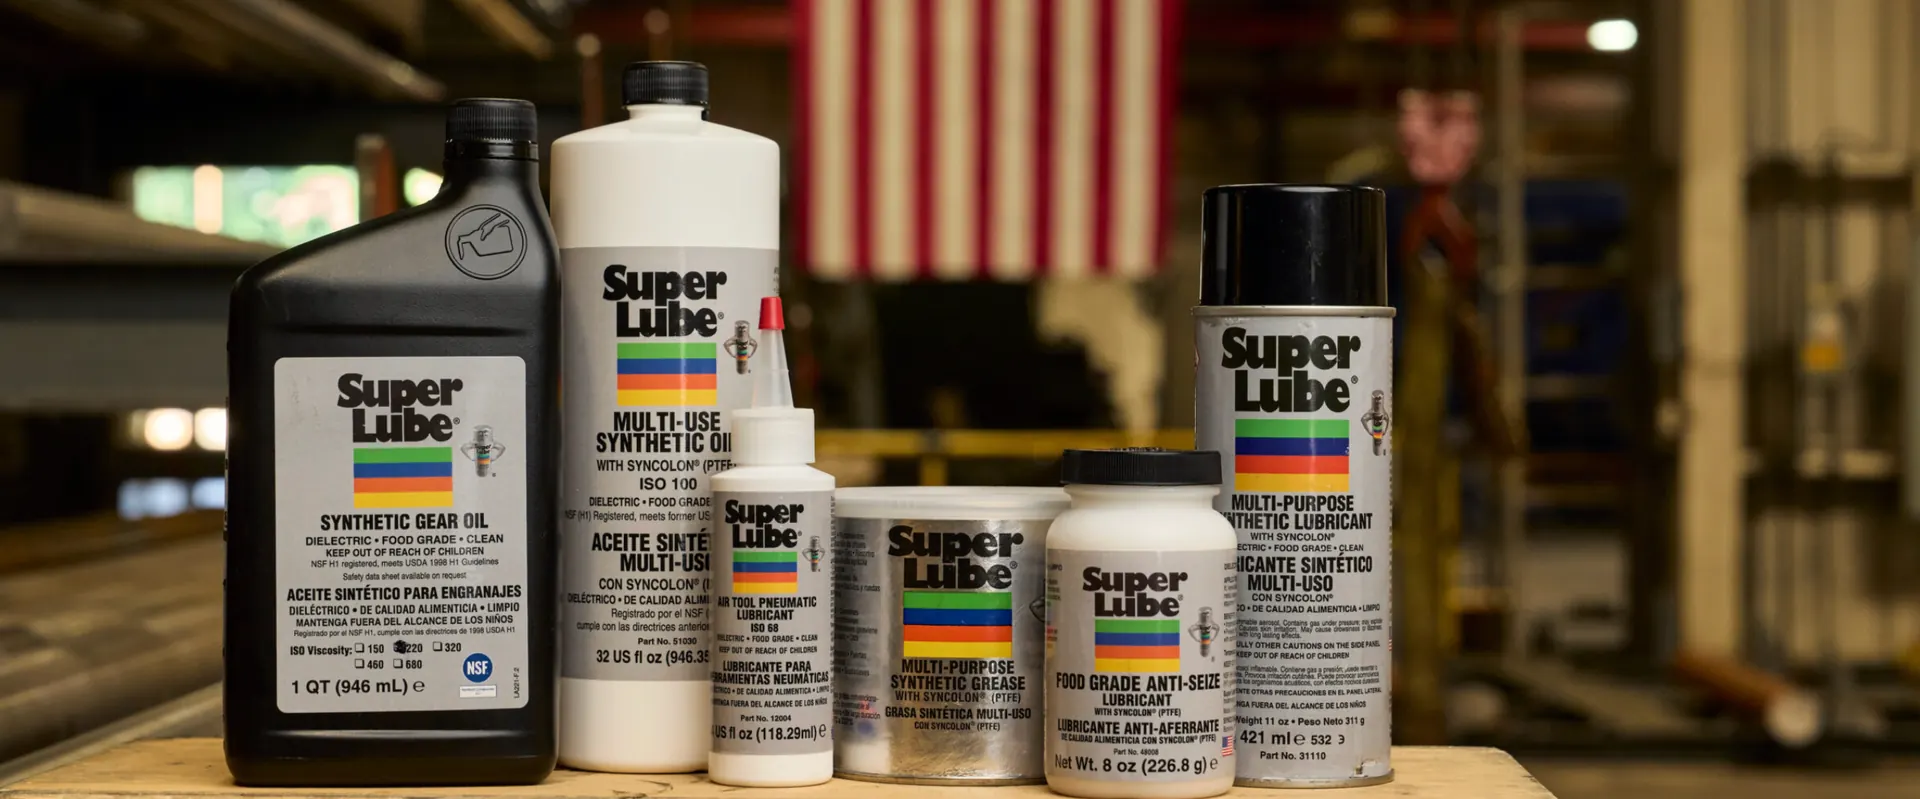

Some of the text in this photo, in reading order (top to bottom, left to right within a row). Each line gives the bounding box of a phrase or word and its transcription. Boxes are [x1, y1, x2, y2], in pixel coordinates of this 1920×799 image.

[603, 264, 727, 306] Super
[1222, 327, 1361, 376] Super
[337, 373, 463, 413] Super
[613, 412, 720, 431] MULTI-USE
[597, 432, 704, 452] SYNTHETIC
[597, 460, 623, 471] WITH
[640, 478, 697, 490] ISO 100
[589, 497, 640, 507] DIELECTRIC
[649, 498, 676, 507] FOOD
[1232, 494, 1354, 512] MULTI-PURPOSE
[725, 500, 804, 527] Super
[321, 513, 488, 530] SYNTHETIC GEAR OIL
[1221, 513, 1372, 530] NTHETIC LUBRICANT
[305, 534, 503, 546] DIELECTRIC FOOD GRADE CLEAN
[592, 528, 710, 551] ACEITE SINTÉ
[888, 525, 1024, 563] Super
[326, 547, 484, 557] KEEP OUT OF REACH OF CHILDREN
[341, 559, 379, 569] registered,
[1237, 553, 1372, 573] RICANTE SINTÉTICO
[599, 578, 623, 590] CON
[1082, 566, 1188, 597] Super
[1248, 575, 1333, 592] MULTI-USO
[287, 584, 521, 601] ACEITE SINTÉTICO PARA ENGRANAJES
[718, 597, 816, 608] AIR TOOL PNEUMATIC
[737, 610, 794, 620] LUBRICANT
[751, 624, 778, 632] ISO 68
[290, 643, 461, 656] ISO Viscosity: 150 220 320
[596, 650, 609, 663] 32
[614, 650, 630, 663] US
[635, 650, 642, 663] fl
[647, 653, 662, 663] oz
[367, 659, 422, 669] 460 680
[467, 661, 488, 675] NSF
[723, 661, 811, 672] LUBRICANTE PARA
[902, 660, 1015, 674] MULTI-PURPOSE
[774, 671, 828, 684] NEUMÁTICAS
[891, 675, 1025, 690] SYNTHETIC GREASE
[1056, 673, 1220, 691] FOOD GRADE ANTI-SEIZE
[292, 679, 408, 697] 1 QT (946 mL)
[895, 691, 919, 702] WITH
[992, 693, 1021, 703] (PTFE)
[1103, 694, 1172, 706] LUBRICANT
[885, 706, 1031, 719] GRASA SINTÉTICA MULTI-USO
[1095, 708, 1112, 716] WITH
[1158, 708, 1181, 717] (PTFE)
[1058, 719, 1219, 735] LUBRICANTE ANTI-AFERRANTE
[1360, 718, 1364, 726] g
[716, 726, 726, 738] US
[730, 727, 735, 738] fl
[739, 729, 752, 739] oz
[1068, 734, 1092, 742] CALIDAD
[1095, 736, 1140, 744] ALIMENTICIA
[1199, 734, 1216, 742] (PTFE)
[1240, 731, 1331, 745] 421 ml 532
[1055, 755, 1206, 776] Net Wt. 8 oz (226.8 g)
